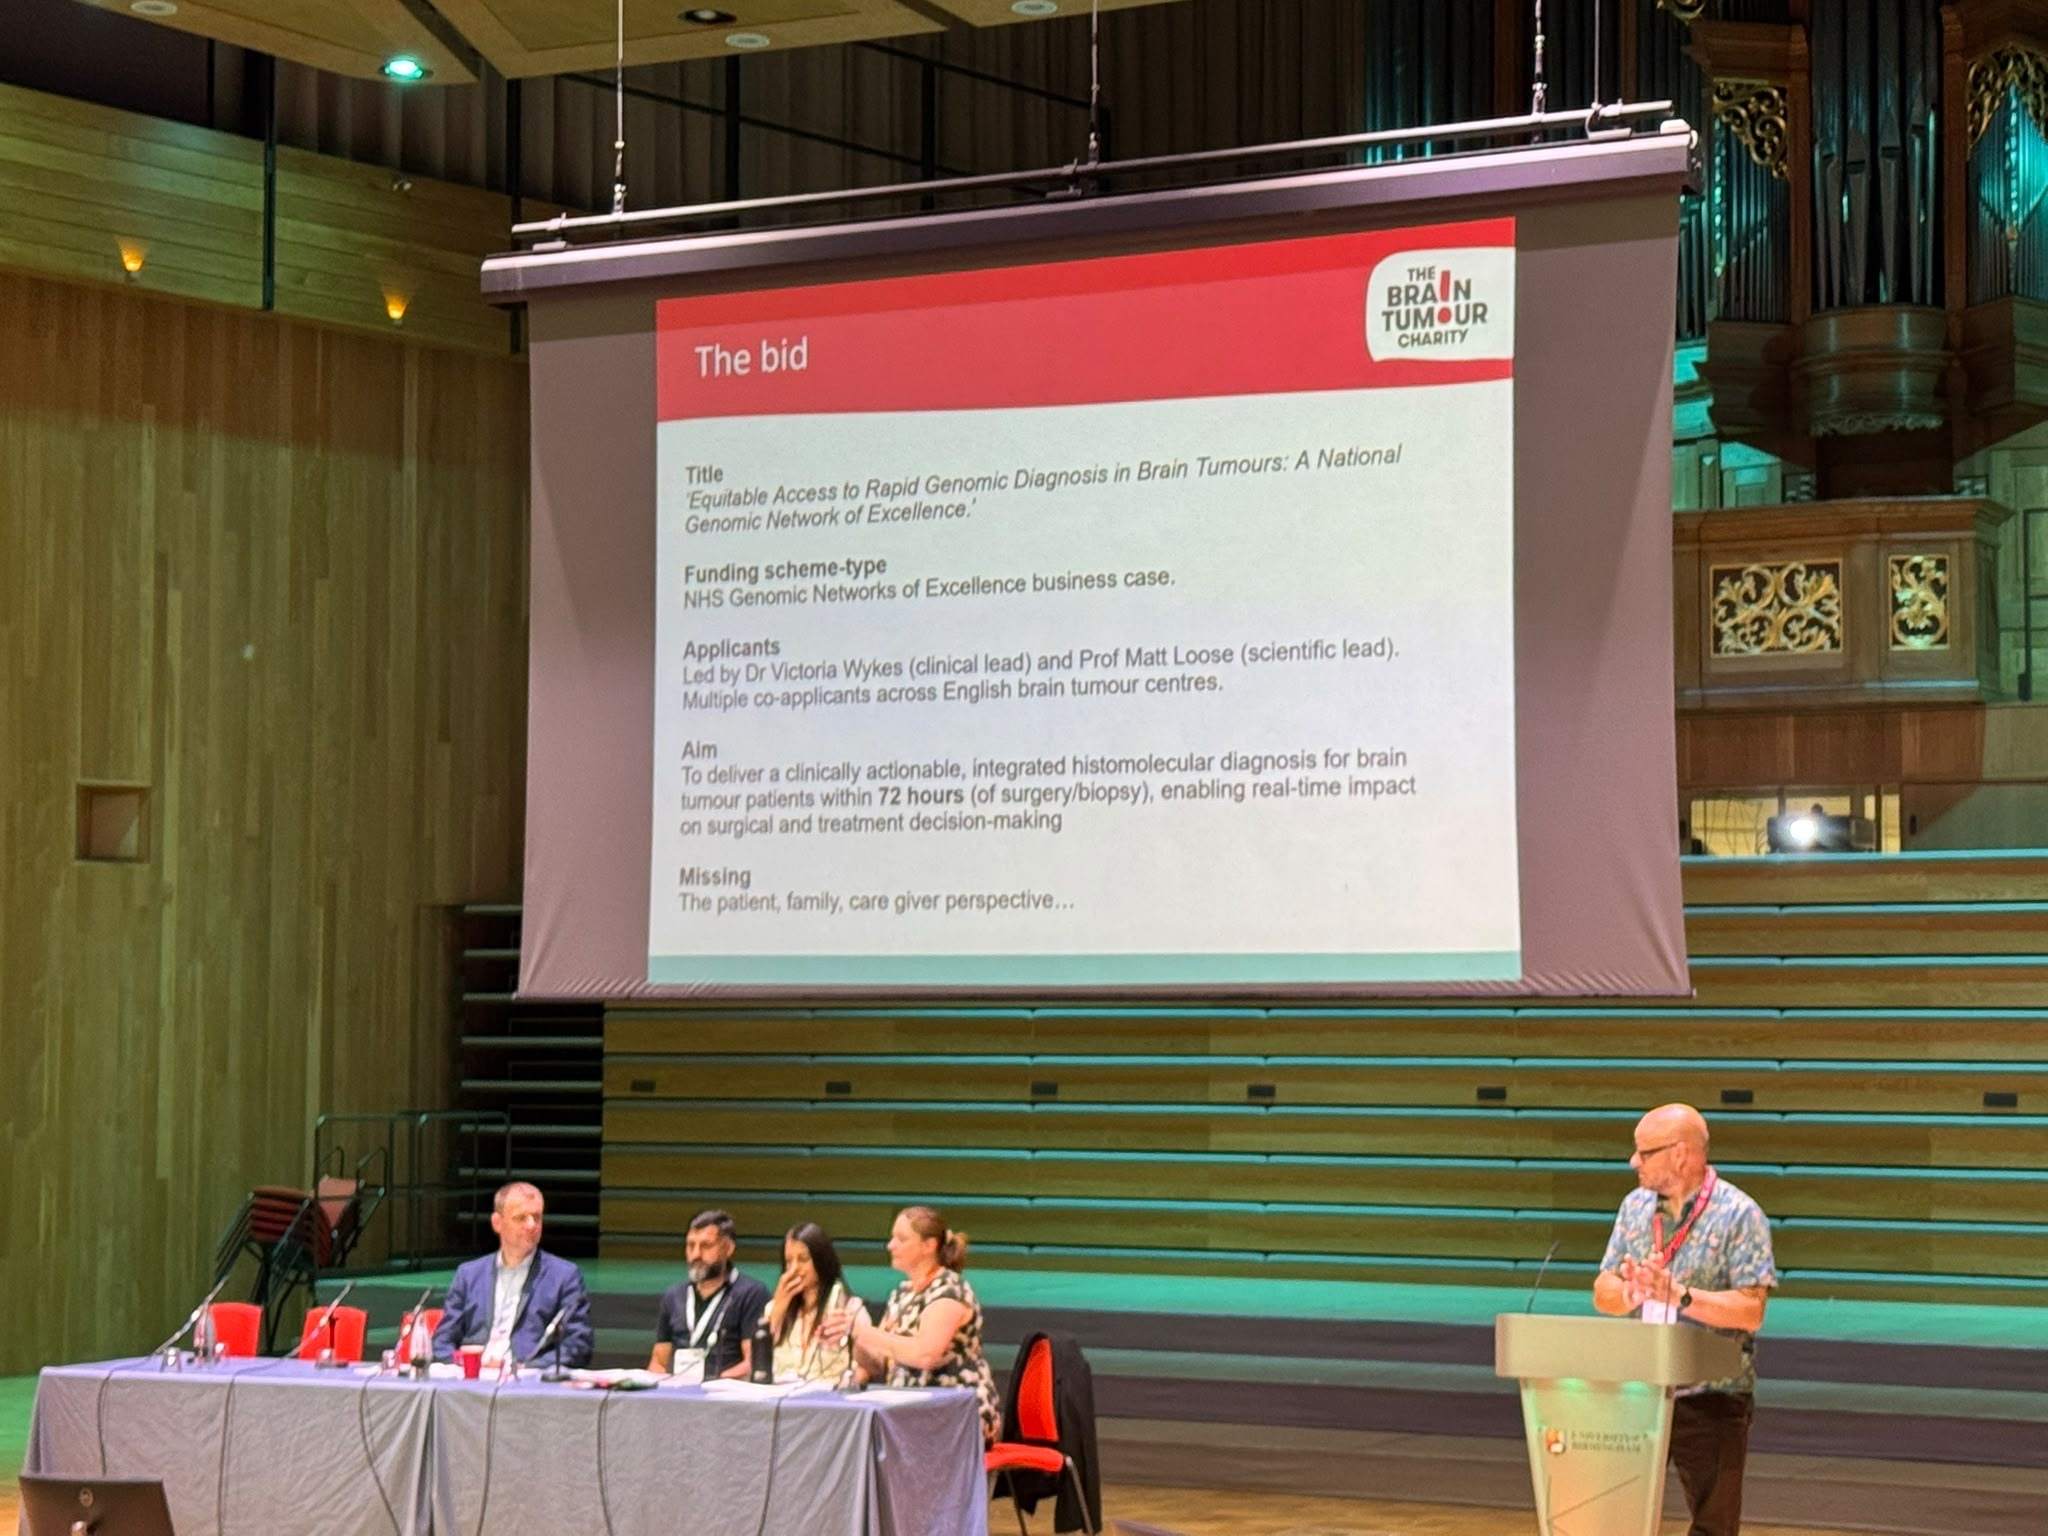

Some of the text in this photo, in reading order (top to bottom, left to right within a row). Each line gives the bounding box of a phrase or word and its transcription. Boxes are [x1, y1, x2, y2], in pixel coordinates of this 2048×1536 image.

[1407, 266, 1436, 282] THE
[1381, 302, 1489, 332] TUMOUR
[1397, 328, 1469, 348] CHARITY
[694, 335, 809, 378] The bid
[685, 465, 724, 485] Title
[772, 485, 838, 505] Access
[842, 482, 860, 501] to
[865, 476, 921, 503] Rapid
[924, 471, 1009, 495] Genomic
[1013, 464, 1109, 492] Diagnosis
[1113, 463, 1131, 483] in
[1137, 458, 1189, 482] Brain
[1196, 455, 1289, 478] Tumours:
[1294, 449, 1310, 471] A
[1317, 443, 1403, 469] National
[685, 511, 762, 534] Genomic
[766, 506, 841, 530] Network
[844, 504, 865, 526] of
[684, 558, 888, 586] Funding scheme-type
[684, 570, 1175, 609] NHS Genomic Networks of Excellence business case.
[683, 638, 781, 664] Applicants
[683, 637, 1399, 687] Led by Dr Victoria Wykes (clinical lead) and Prof Matt Loose (scientific lead).
[683, 673, 1223, 713] Multiple co-applicants across English brain tumour centres.
[681, 740, 718, 760] Aim
[682, 746, 1407, 785] To deliver a clinically actionable, integrated histomolecular diagnosis for brain
[681, 775, 1416, 814] tumour patients within 72 hours (of surgery/biopsy), enabling real-time impact
[680, 809, 1063, 839] on surgical and treatment decision-making
[679, 867, 751, 890] Missing
[680, 892, 712, 911] The
[717, 893, 780, 916] patient,
[786, 891, 843, 915] family,
[849, 895, 890, 911] care
[894, 890, 940, 915] giver
